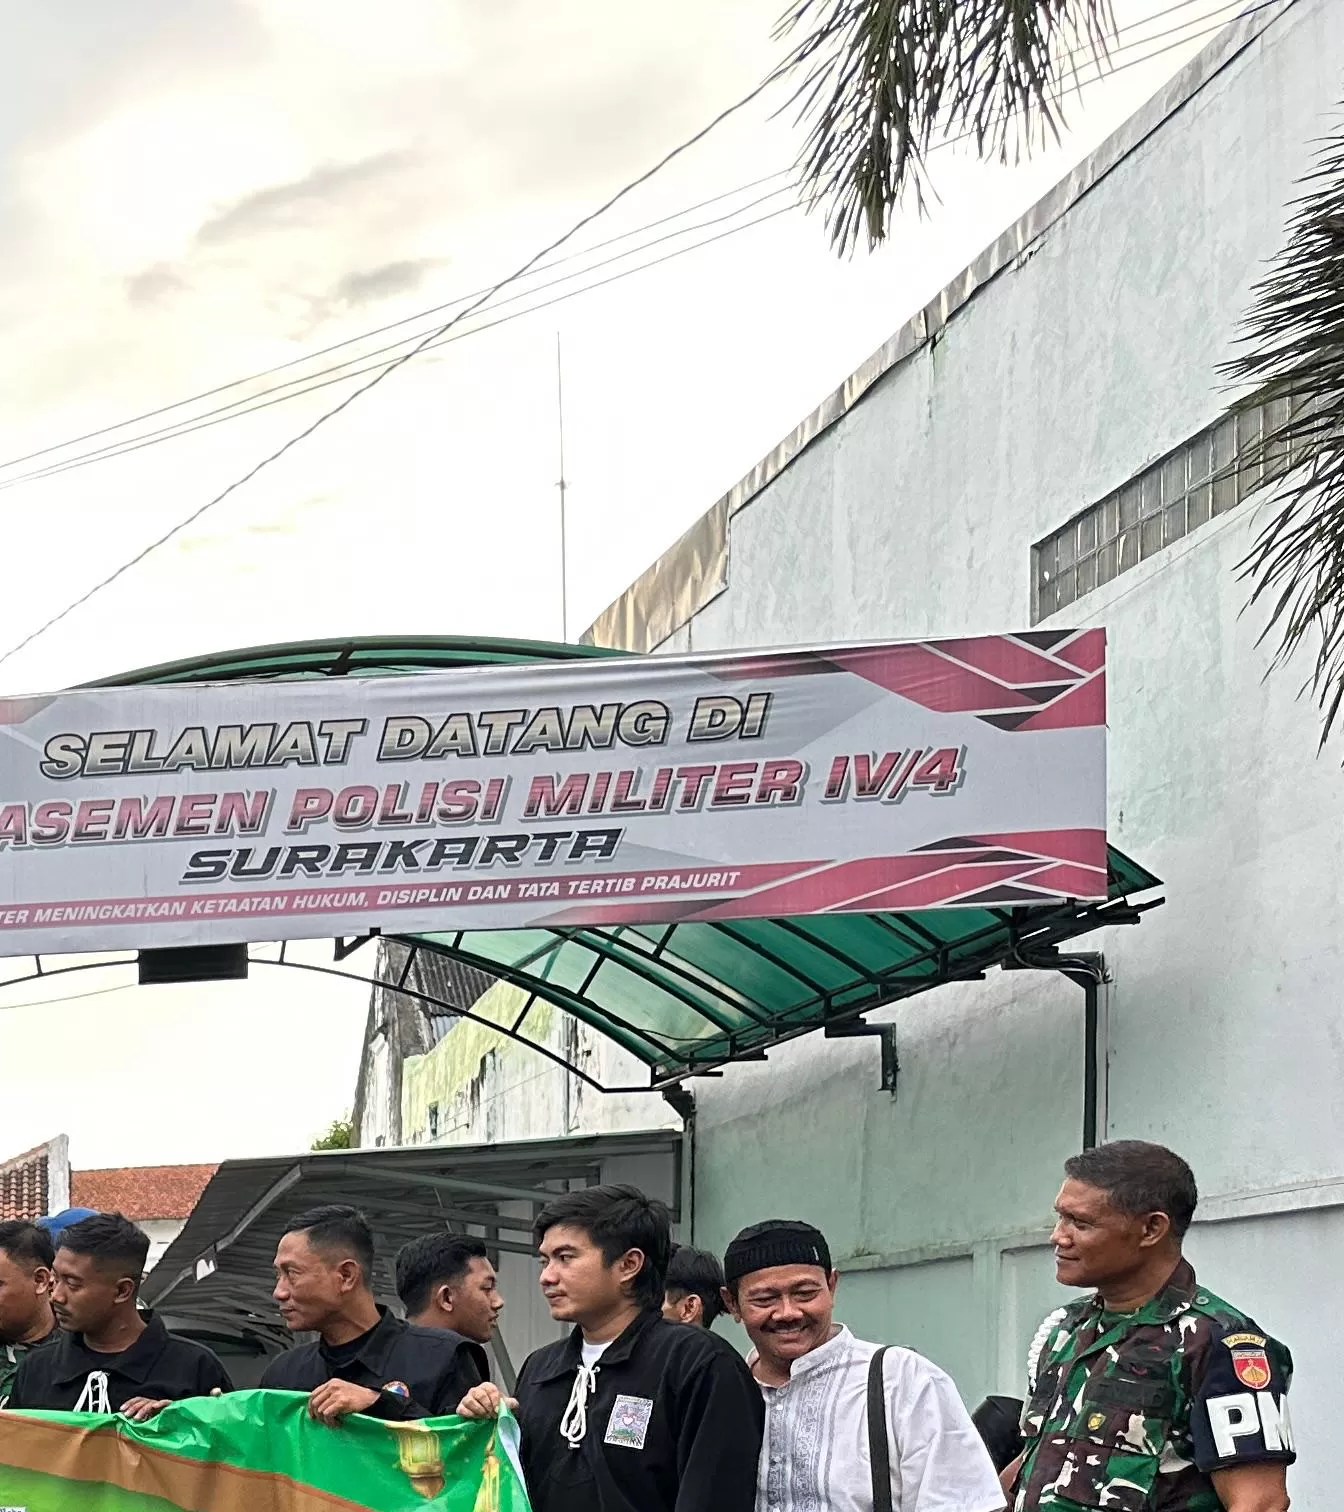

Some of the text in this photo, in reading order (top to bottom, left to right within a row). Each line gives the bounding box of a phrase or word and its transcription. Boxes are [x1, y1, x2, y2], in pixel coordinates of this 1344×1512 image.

[40, 692, 774, 780] SELAMAT DATANG DI
[284, 775, 506, 834] POLISI
[520, 757, 814, 828] MILITER
[824, 745, 967, 805] IV/4
[179, 827, 627, 885] SURAKARTA
[34, 902, 185, 923] MENINGKATKAN
[190, 896, 288, 916] KETAATAN
[293, 892, 369, 910] HUKUM,
[376, 886, 461, 905] DISIPLIN
[467, 883, 513, 901] DAN
[517, 881, 561, 898] TATA
[568, 877, 635, 896] TERTIB
[641, 871, 742, 892] PRAJURIT
[1205, 1391, 1295, 1458] PM
